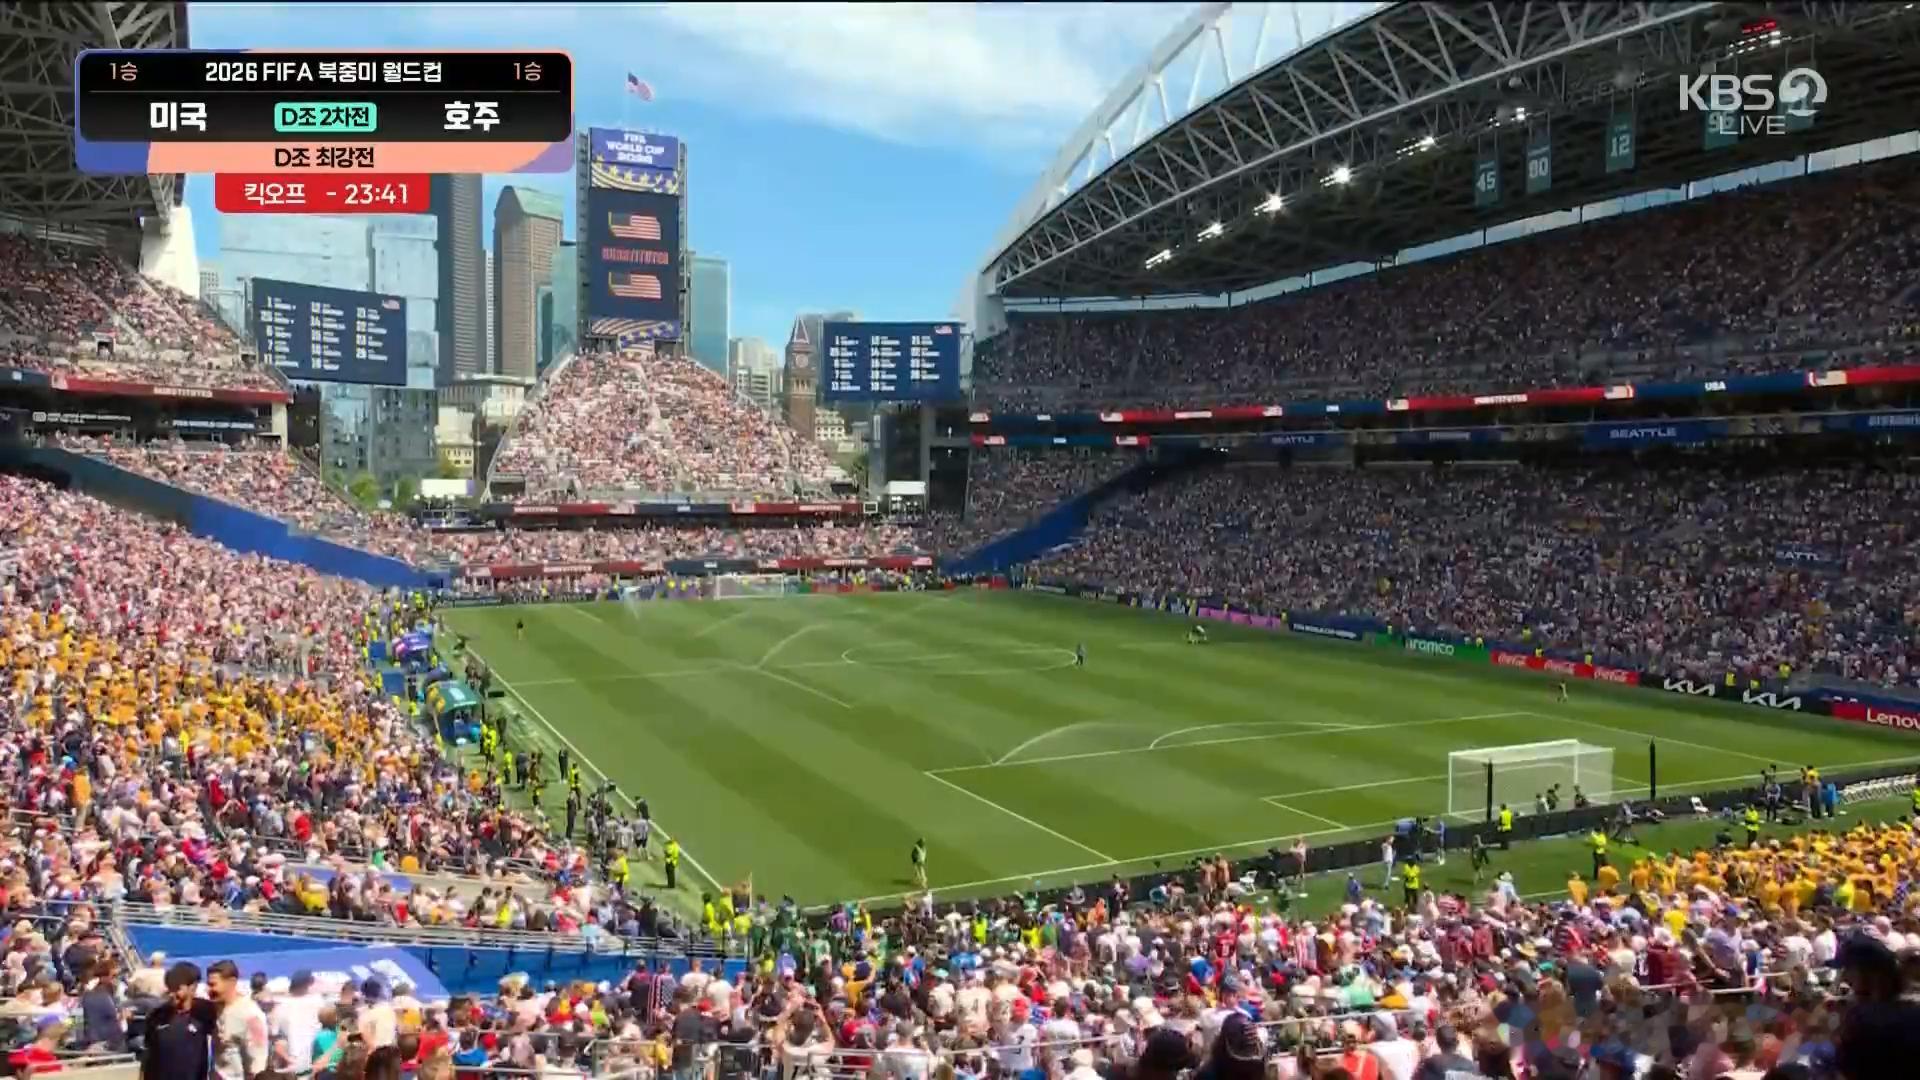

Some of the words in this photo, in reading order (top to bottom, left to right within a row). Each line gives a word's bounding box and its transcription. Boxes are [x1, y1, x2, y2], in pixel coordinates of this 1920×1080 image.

[624, 133, 647, 144] FIFA
[606, 140, 643, 153] WORLD
[644, 144, 665, 155] CUP
[1609, 134, 1630, 158] 12
[1476, 170, 1496, 192] 45
[1704, 380, 1727, 392] USA
[1609, 427, 1677, 440] SEATTLE
